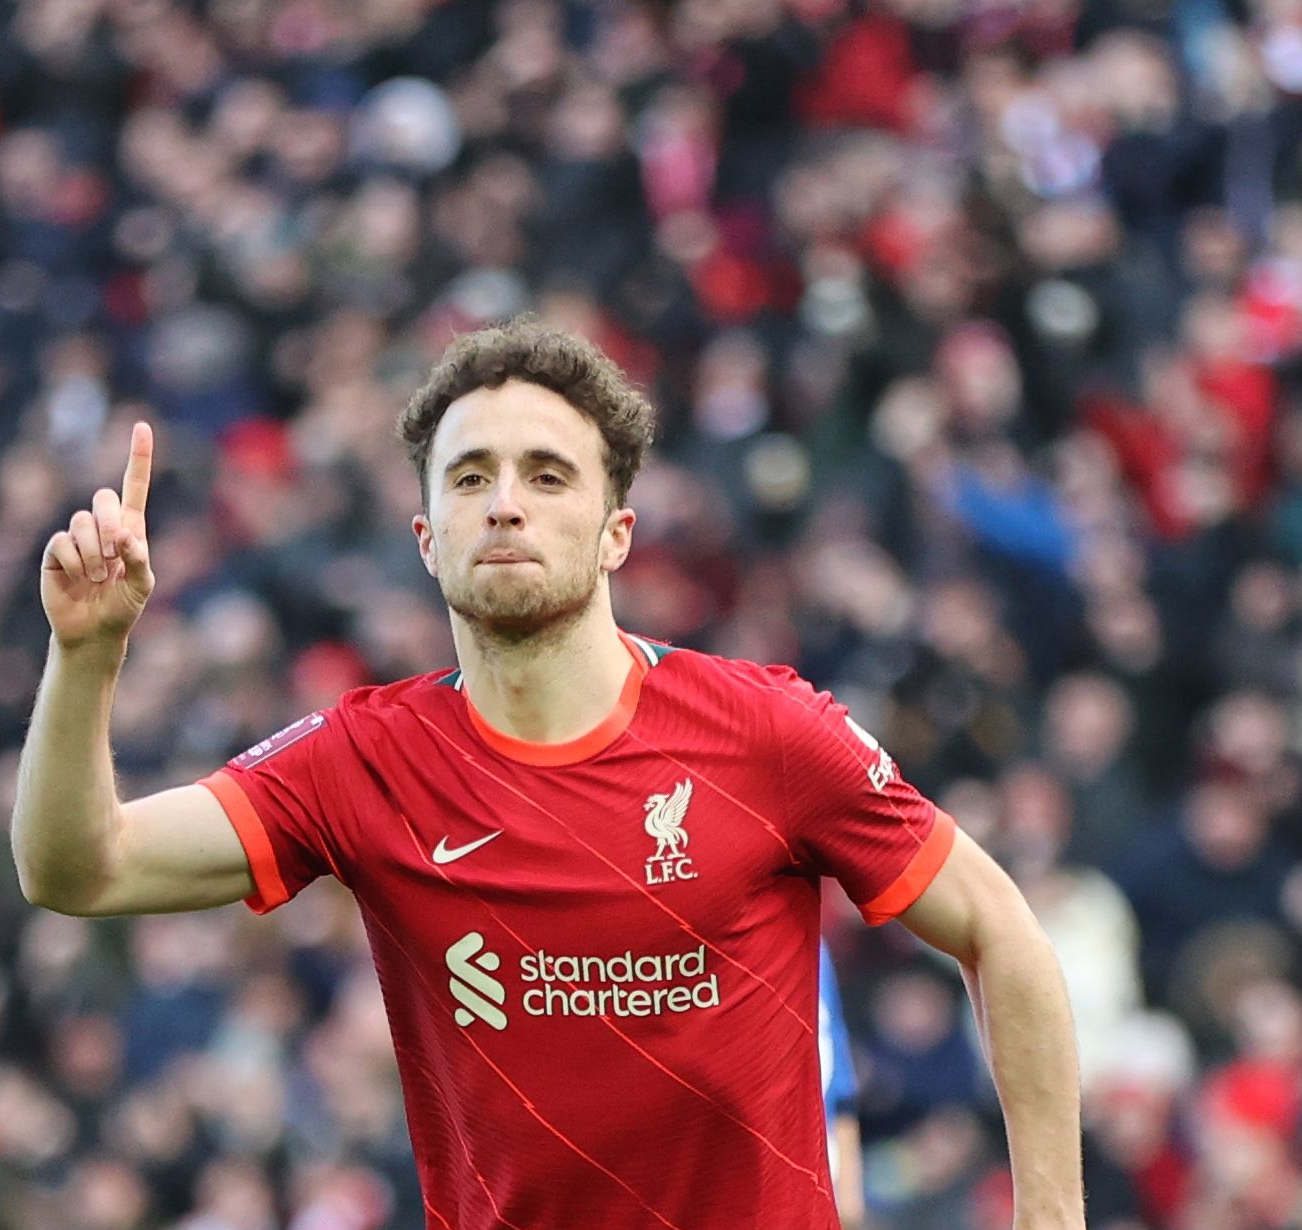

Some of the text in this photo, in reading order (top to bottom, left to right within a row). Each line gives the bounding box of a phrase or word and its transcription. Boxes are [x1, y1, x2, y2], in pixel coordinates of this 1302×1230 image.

[644, 858, 699, 885] L.F.C.
[520, 944, 706, 983] standard
[522, 973, 721, 1017] chartered
